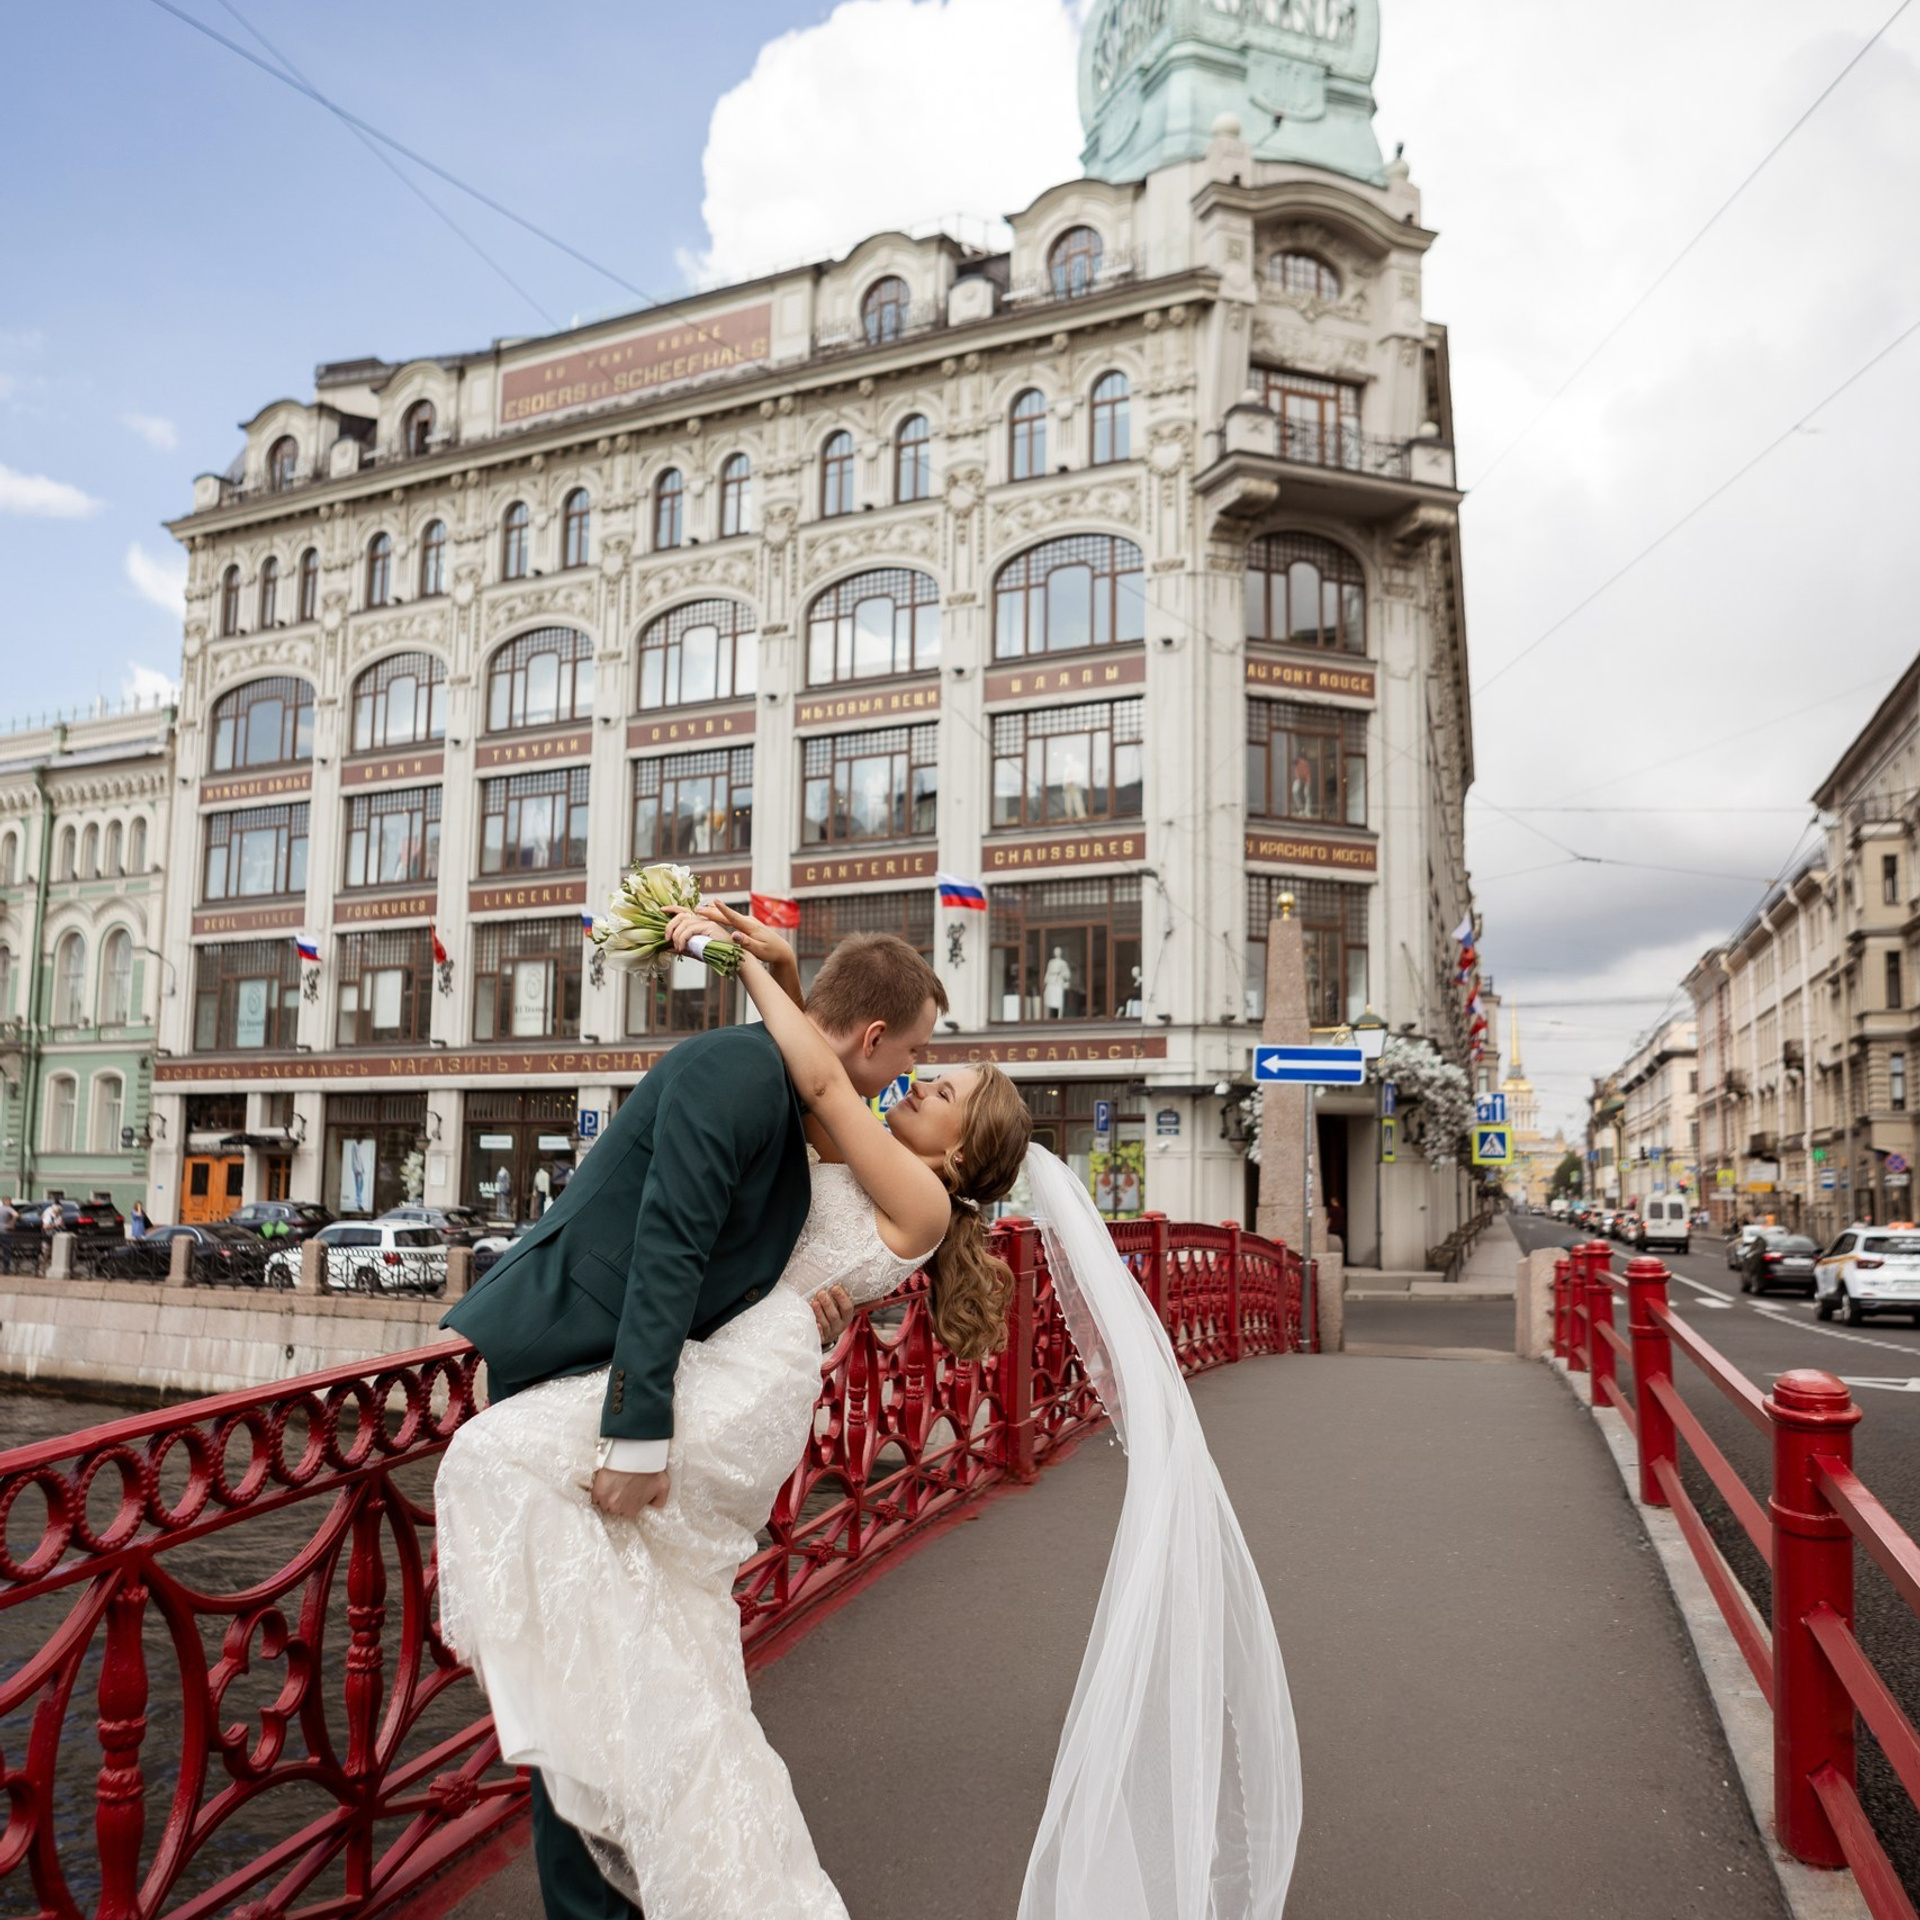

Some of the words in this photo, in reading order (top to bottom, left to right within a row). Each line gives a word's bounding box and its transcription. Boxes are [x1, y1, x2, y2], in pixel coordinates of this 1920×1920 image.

[1010, 665, 1119, 694] ШЛЯПЫ
[1247, 662, 1268, 679] AU
[1272, 665, 1314, 685] PONT
[1319, 671, 1371, 692] ROUGE
[890, 689, 938, 710] ВЕЩИ
[651, 717, 734, 741] ОБУВЬ
[492, 738, 579, 762] ТУЖУРКИ
[364, 760, 422, 779] ЮБКИ
[993, 839, 1135, 866] CHAUSSURES
[1259, 841, 1327, 861] КРАСНАГО
[1332, 846, 1376, 865] МОСТА
[704, 872, 741, 889] AUX
[346, 898, 427, 918] FOURRURES
[483, 886, 574, 908] LINGERIE
[547, 1052, 661, 1072] КРАСНАГ
